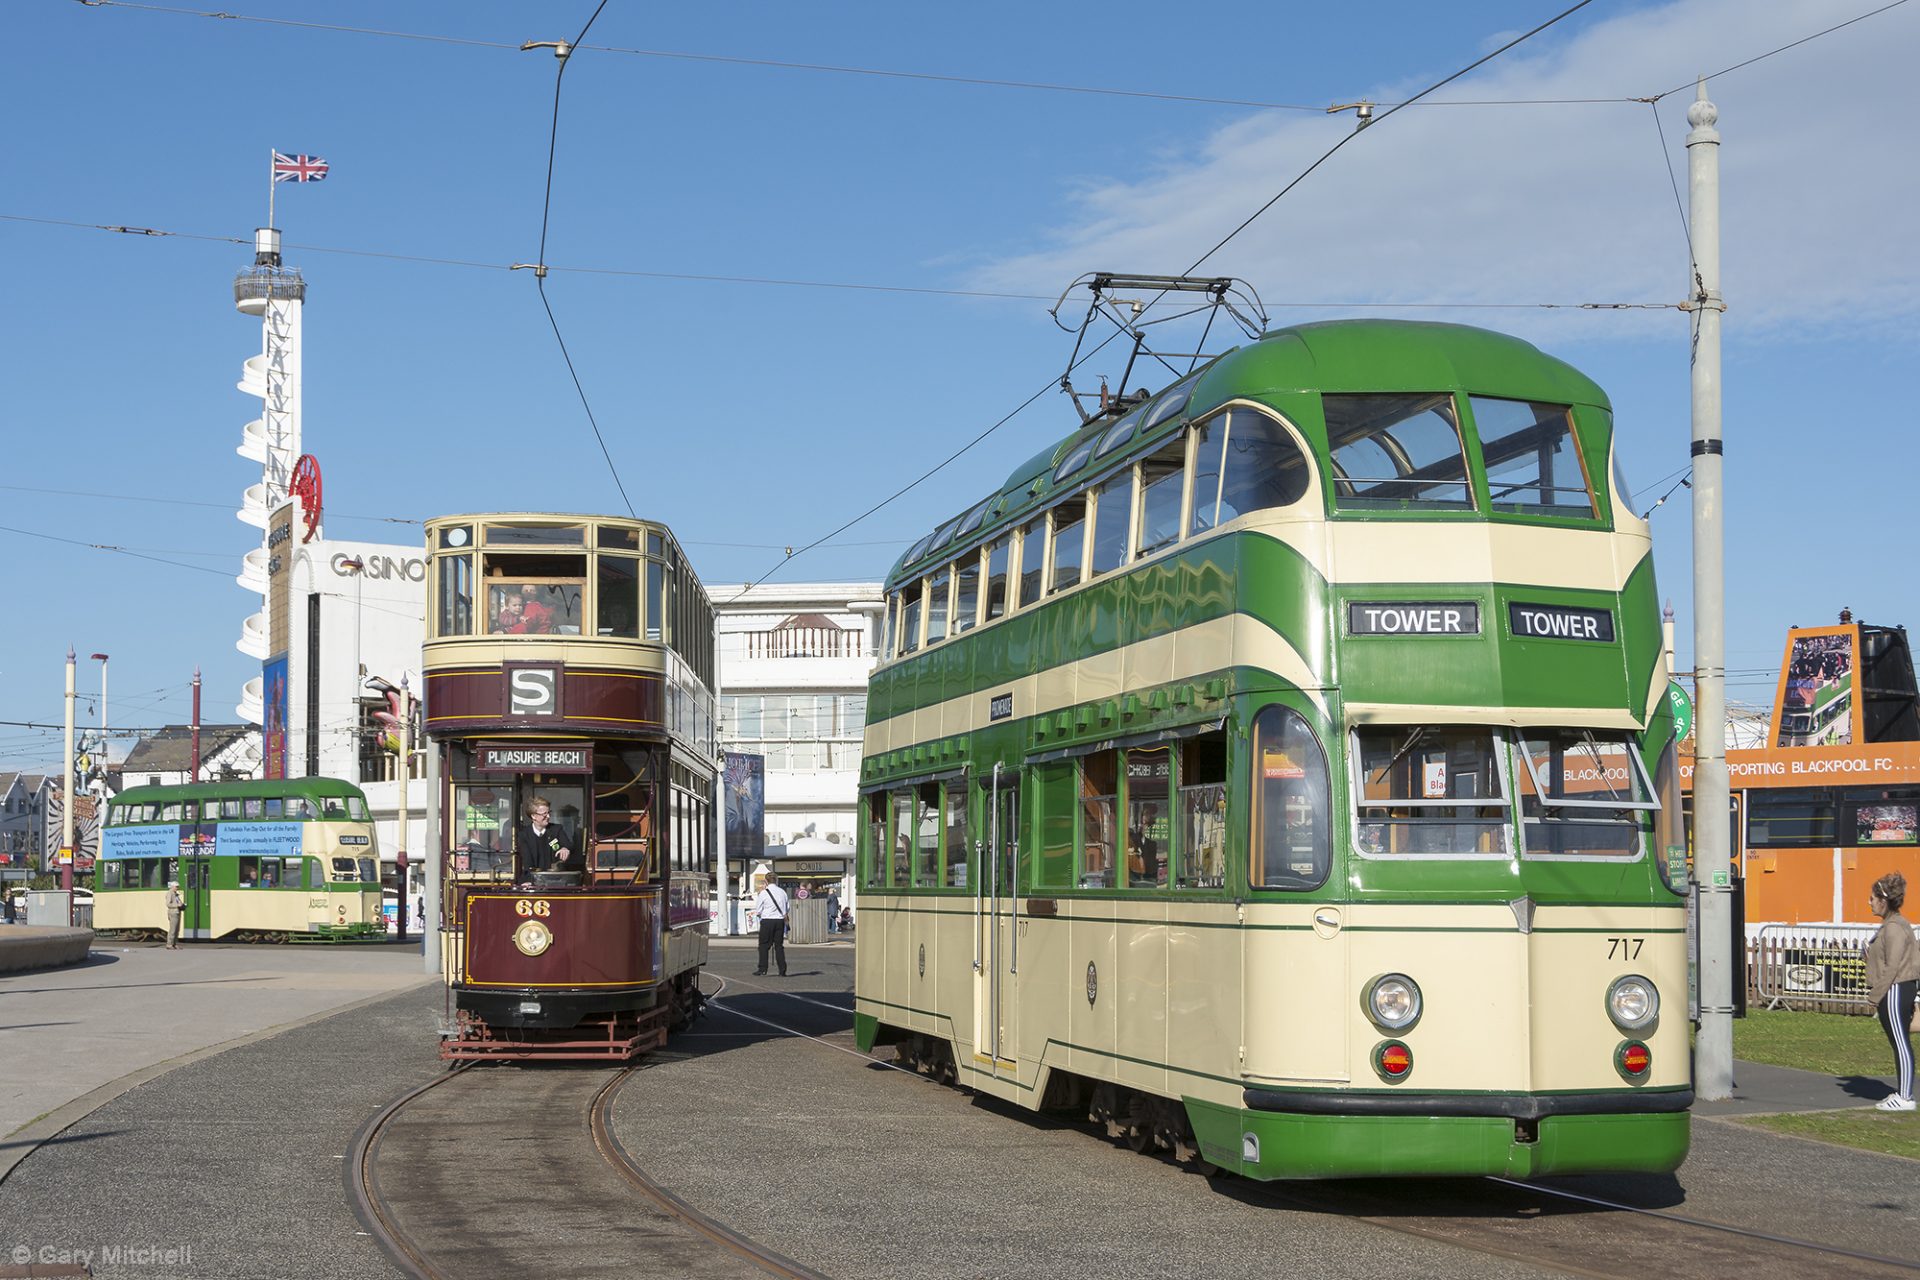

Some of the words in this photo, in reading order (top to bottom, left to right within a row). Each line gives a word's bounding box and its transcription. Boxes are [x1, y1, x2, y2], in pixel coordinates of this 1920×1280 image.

[330, 552, 425, 582] CASINO
[1364, 609, 1461, 632] TOWER
[1520, 611, 1599, 638] TOWER
[511, 669, 553, 706] S
[544, 750, 580, 764] BEACH
[1563, 767, 1630, 781] BLACKPOOL
[1791, 759, 1871, 774] BLACKPOOL
[1874, 758, 1893, 771] FC
[515, 899, 551, 917] 66
[1606, 938, 1646, 961] 717
